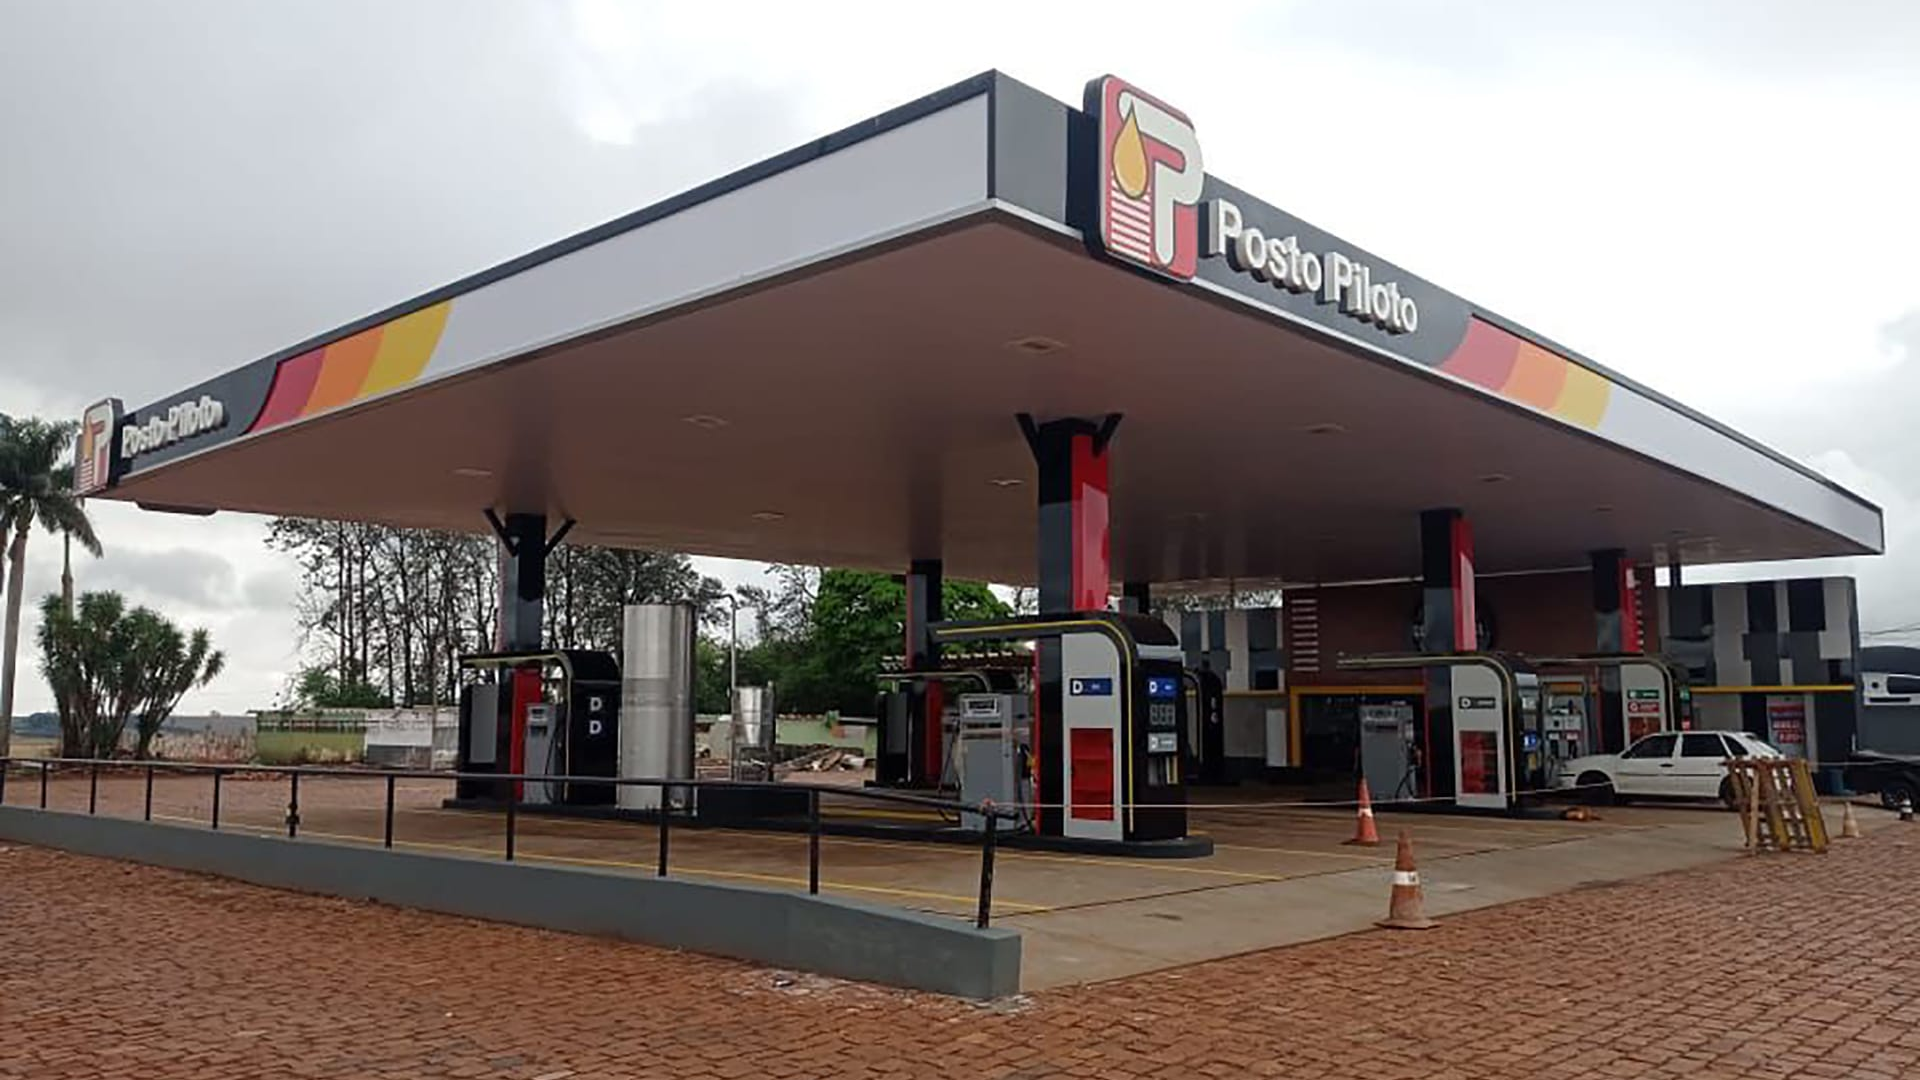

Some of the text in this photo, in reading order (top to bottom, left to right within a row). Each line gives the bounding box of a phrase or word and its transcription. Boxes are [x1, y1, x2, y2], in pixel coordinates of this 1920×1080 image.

[1209, 198, 1418, 333] Posto Piloto
[122, 395, 223, 458] Posto Piloto
[1072, 680, 1084, 694] D
[1149, 681, 1158, 693] D
[589, 696, 603, 712] D
[589, 720, 602, 735] D
